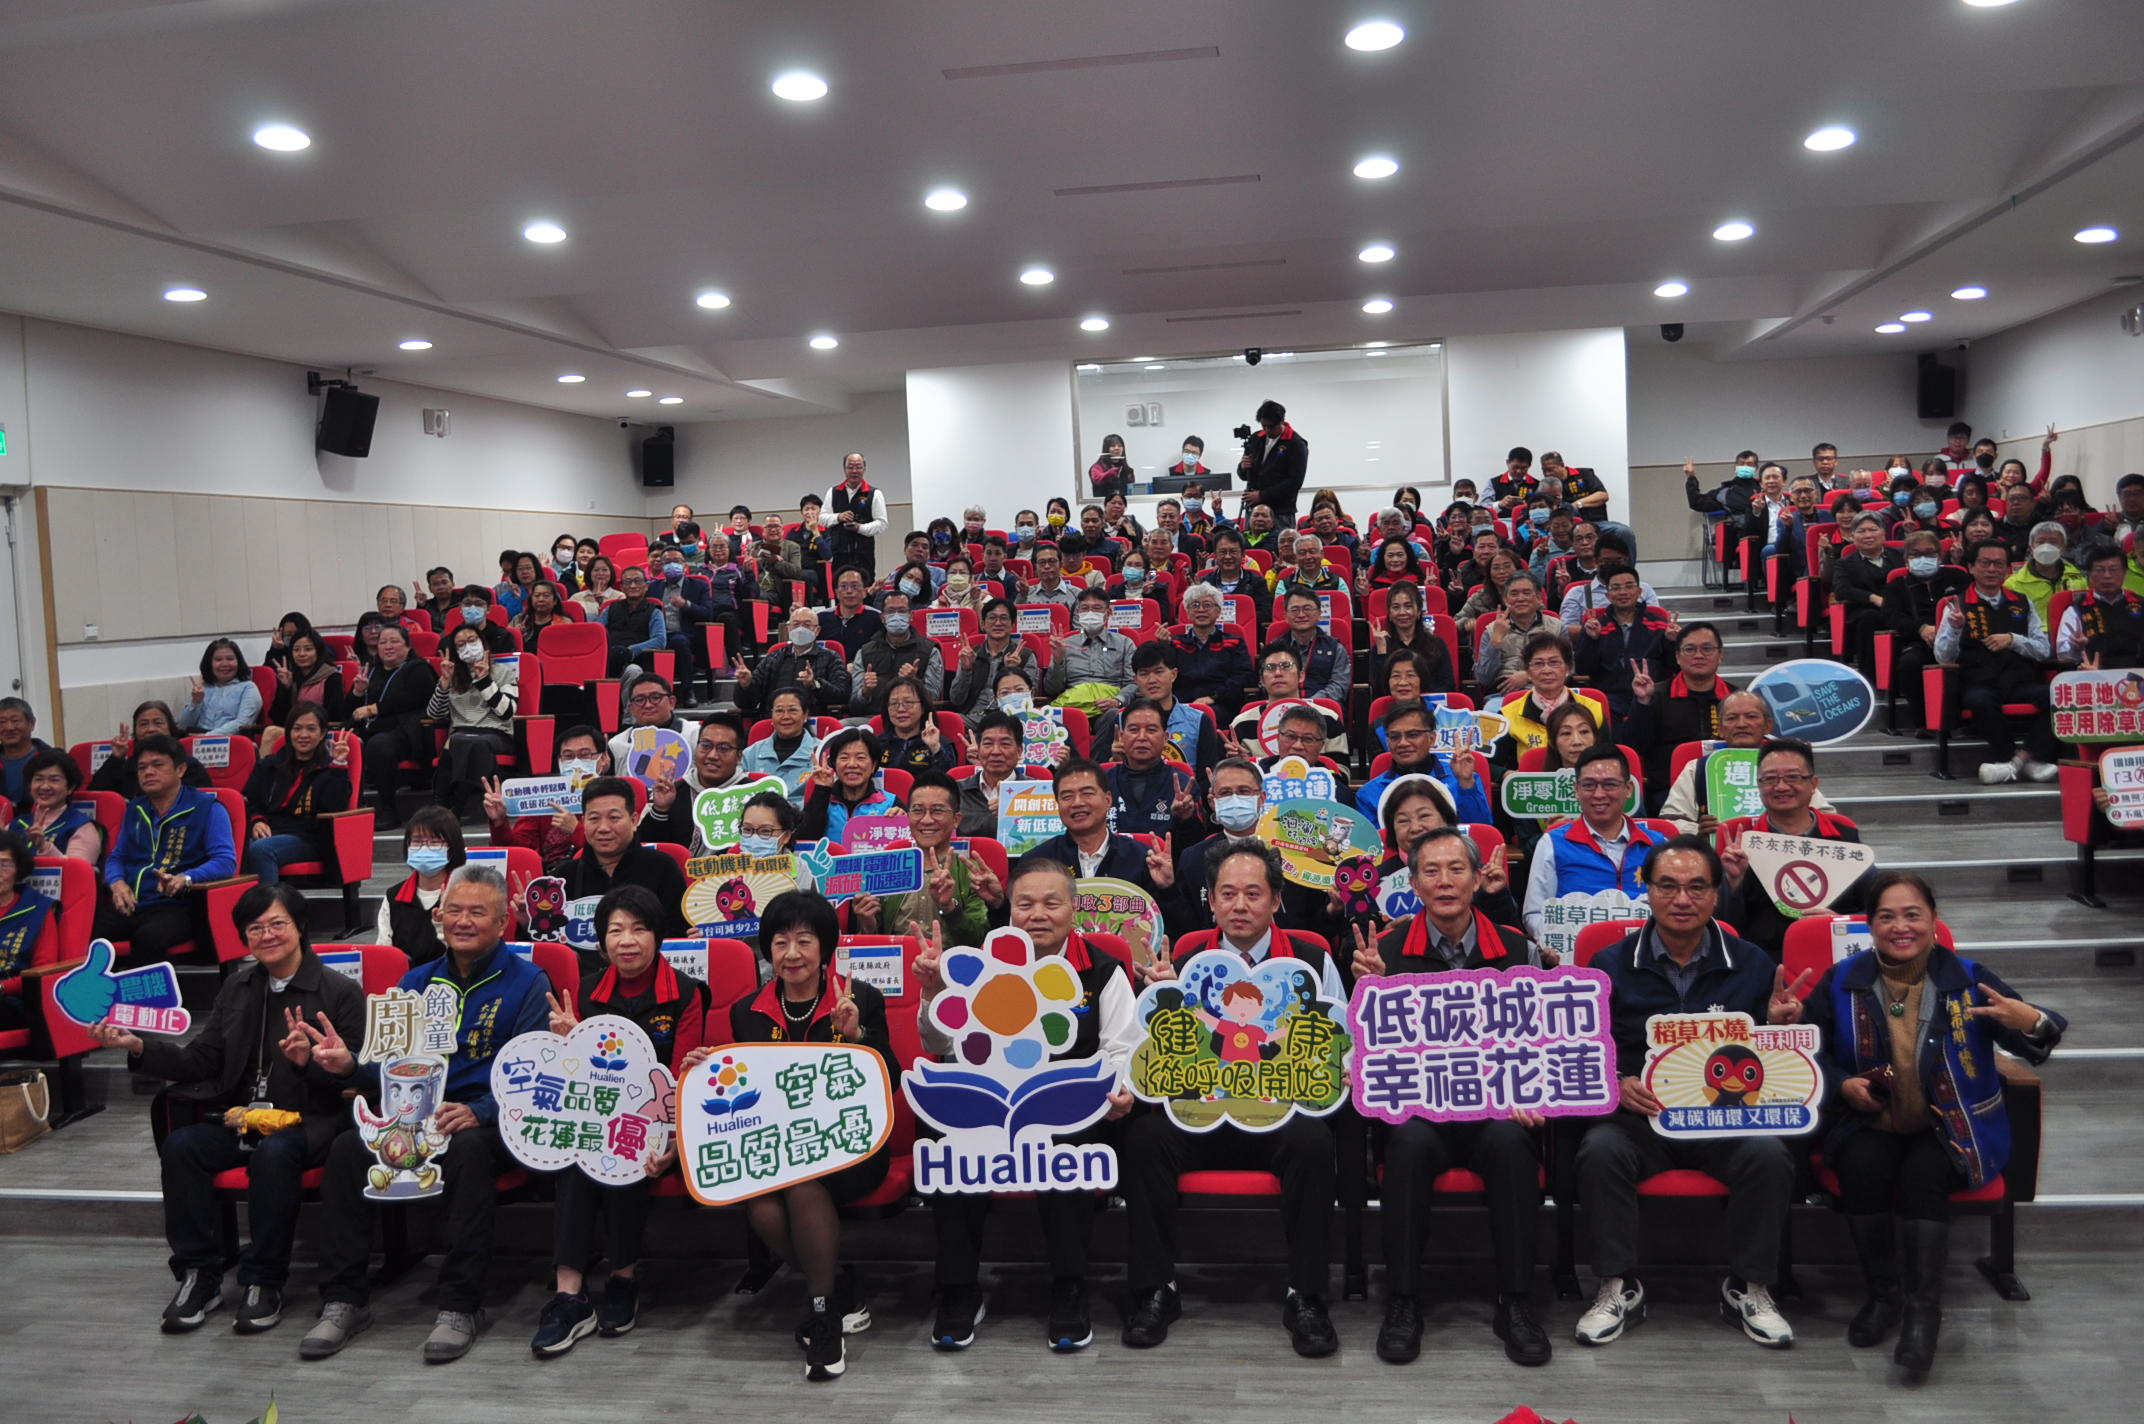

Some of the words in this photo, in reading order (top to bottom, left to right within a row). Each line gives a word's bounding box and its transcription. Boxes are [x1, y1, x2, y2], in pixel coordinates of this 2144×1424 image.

[1814, 680, 1839, 699] SAVE
[1819, 693, 1841, 709] THE
[2054, 682, 2115, 706] 非農地
[1824, 697, 1861, 720] OCEANS
[2055, 711, 2144, 736] 禁用除草
[1013, 797, 1060, 813] 開創花
[1526, 801, 1558, 813] Green
[1748, 834, 1865, 862] 菸灰菸蒂不落地
[686, 854, 752, 877] 電動機車
[119, 971, 169, 1003] 農機
[114, 1003, 182, 1032] 電動化
[361, 991, 422, 1060] 廚
[425, 988, 452, 1052] 餘童
[1359, 978, 1599, 1049] 低碳城市
[1149, 1008, 1200, 1058] 健
[1284, 1011, 1337, 1062] 康
[1652, 1018, 1749, 1045] 稻草不燒
[1754, 1029, 1814, 1051] 再利用
[502, 1056, 622, 1117] 空氣品質
[589, 1070, 626, 1085] Hualien
[775, 1052, 866, 1110] 空氣
[1148, 1059, 1333, 1101] 從呼吸開始
[1365, 1042, 1607, 1110] 幸福花蓮
[706, 1113, 763, 1137] Hualien
[1668, 1107, 1803, 1128] 減碳循環又環保
[520, 1112, 653, 1162] 花蓮最優
[697, 1104, 874, 1189] 品質最優
[920, 1142, 1112, 1188] Hualien
